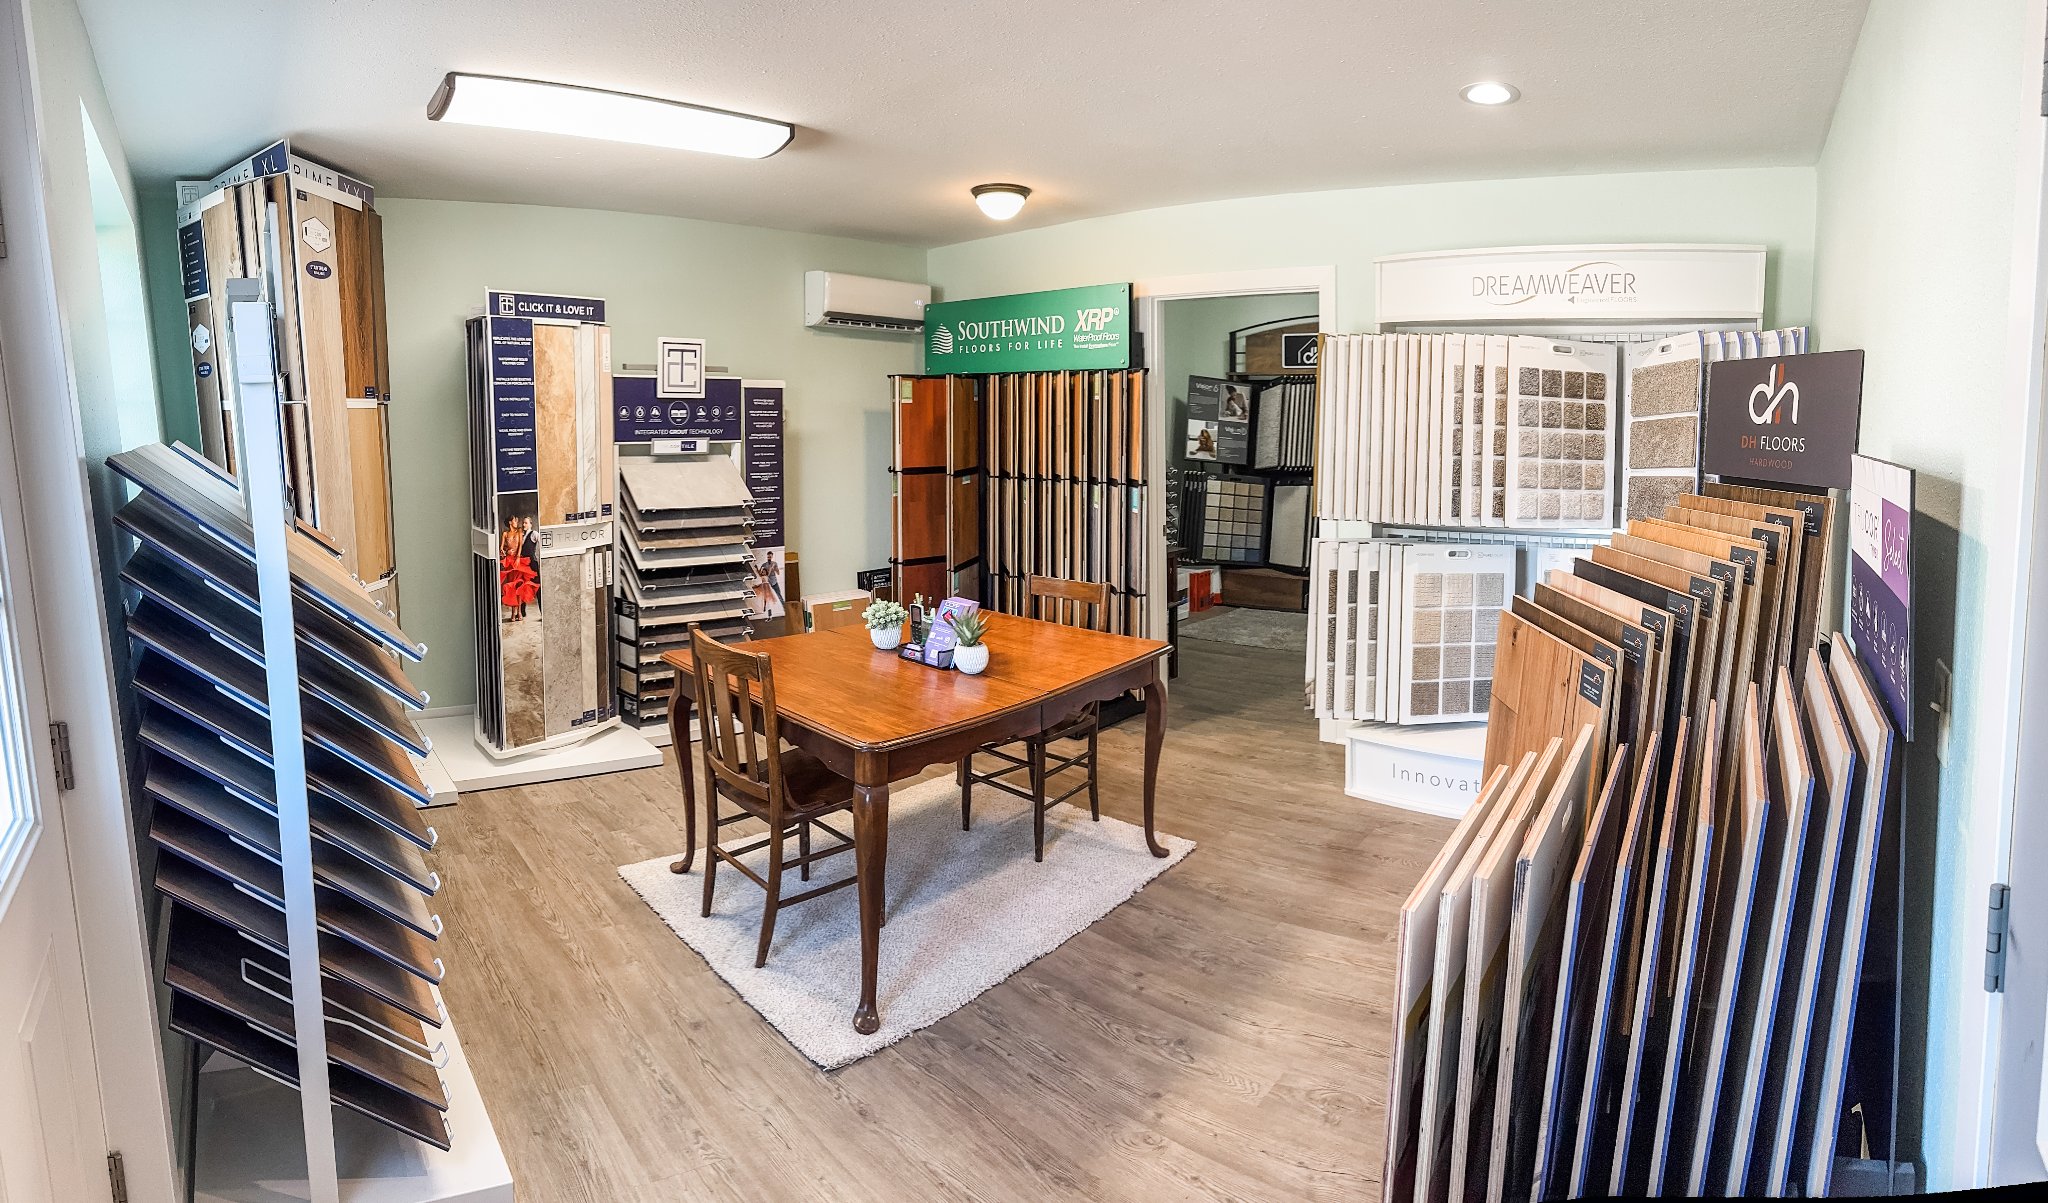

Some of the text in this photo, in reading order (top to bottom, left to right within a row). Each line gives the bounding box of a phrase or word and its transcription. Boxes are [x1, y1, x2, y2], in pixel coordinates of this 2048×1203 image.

[1472, 272, 1637, 298] DREAMWEAVER
[518, 302, 544, 312] CLICK
[545, 304, 553, 313] IT
[555, 304, 562, 313] &
[563, 305, 585, 315] LOVE
[586, 306, 595, 316] IT
[957, 315, 1065, 341] SOUTHWIND
[959, 343, 1001, 354] FLOORS
[1008, 341, 1030, 351] FOR
[1037, 338, 1064, 350] LIFE
[1741, 435, 1806, 452] DH FLOORS
[1750, 458, 1793, 470] HARDWOOD
[557, 530, 605, 542] TRUCOR
